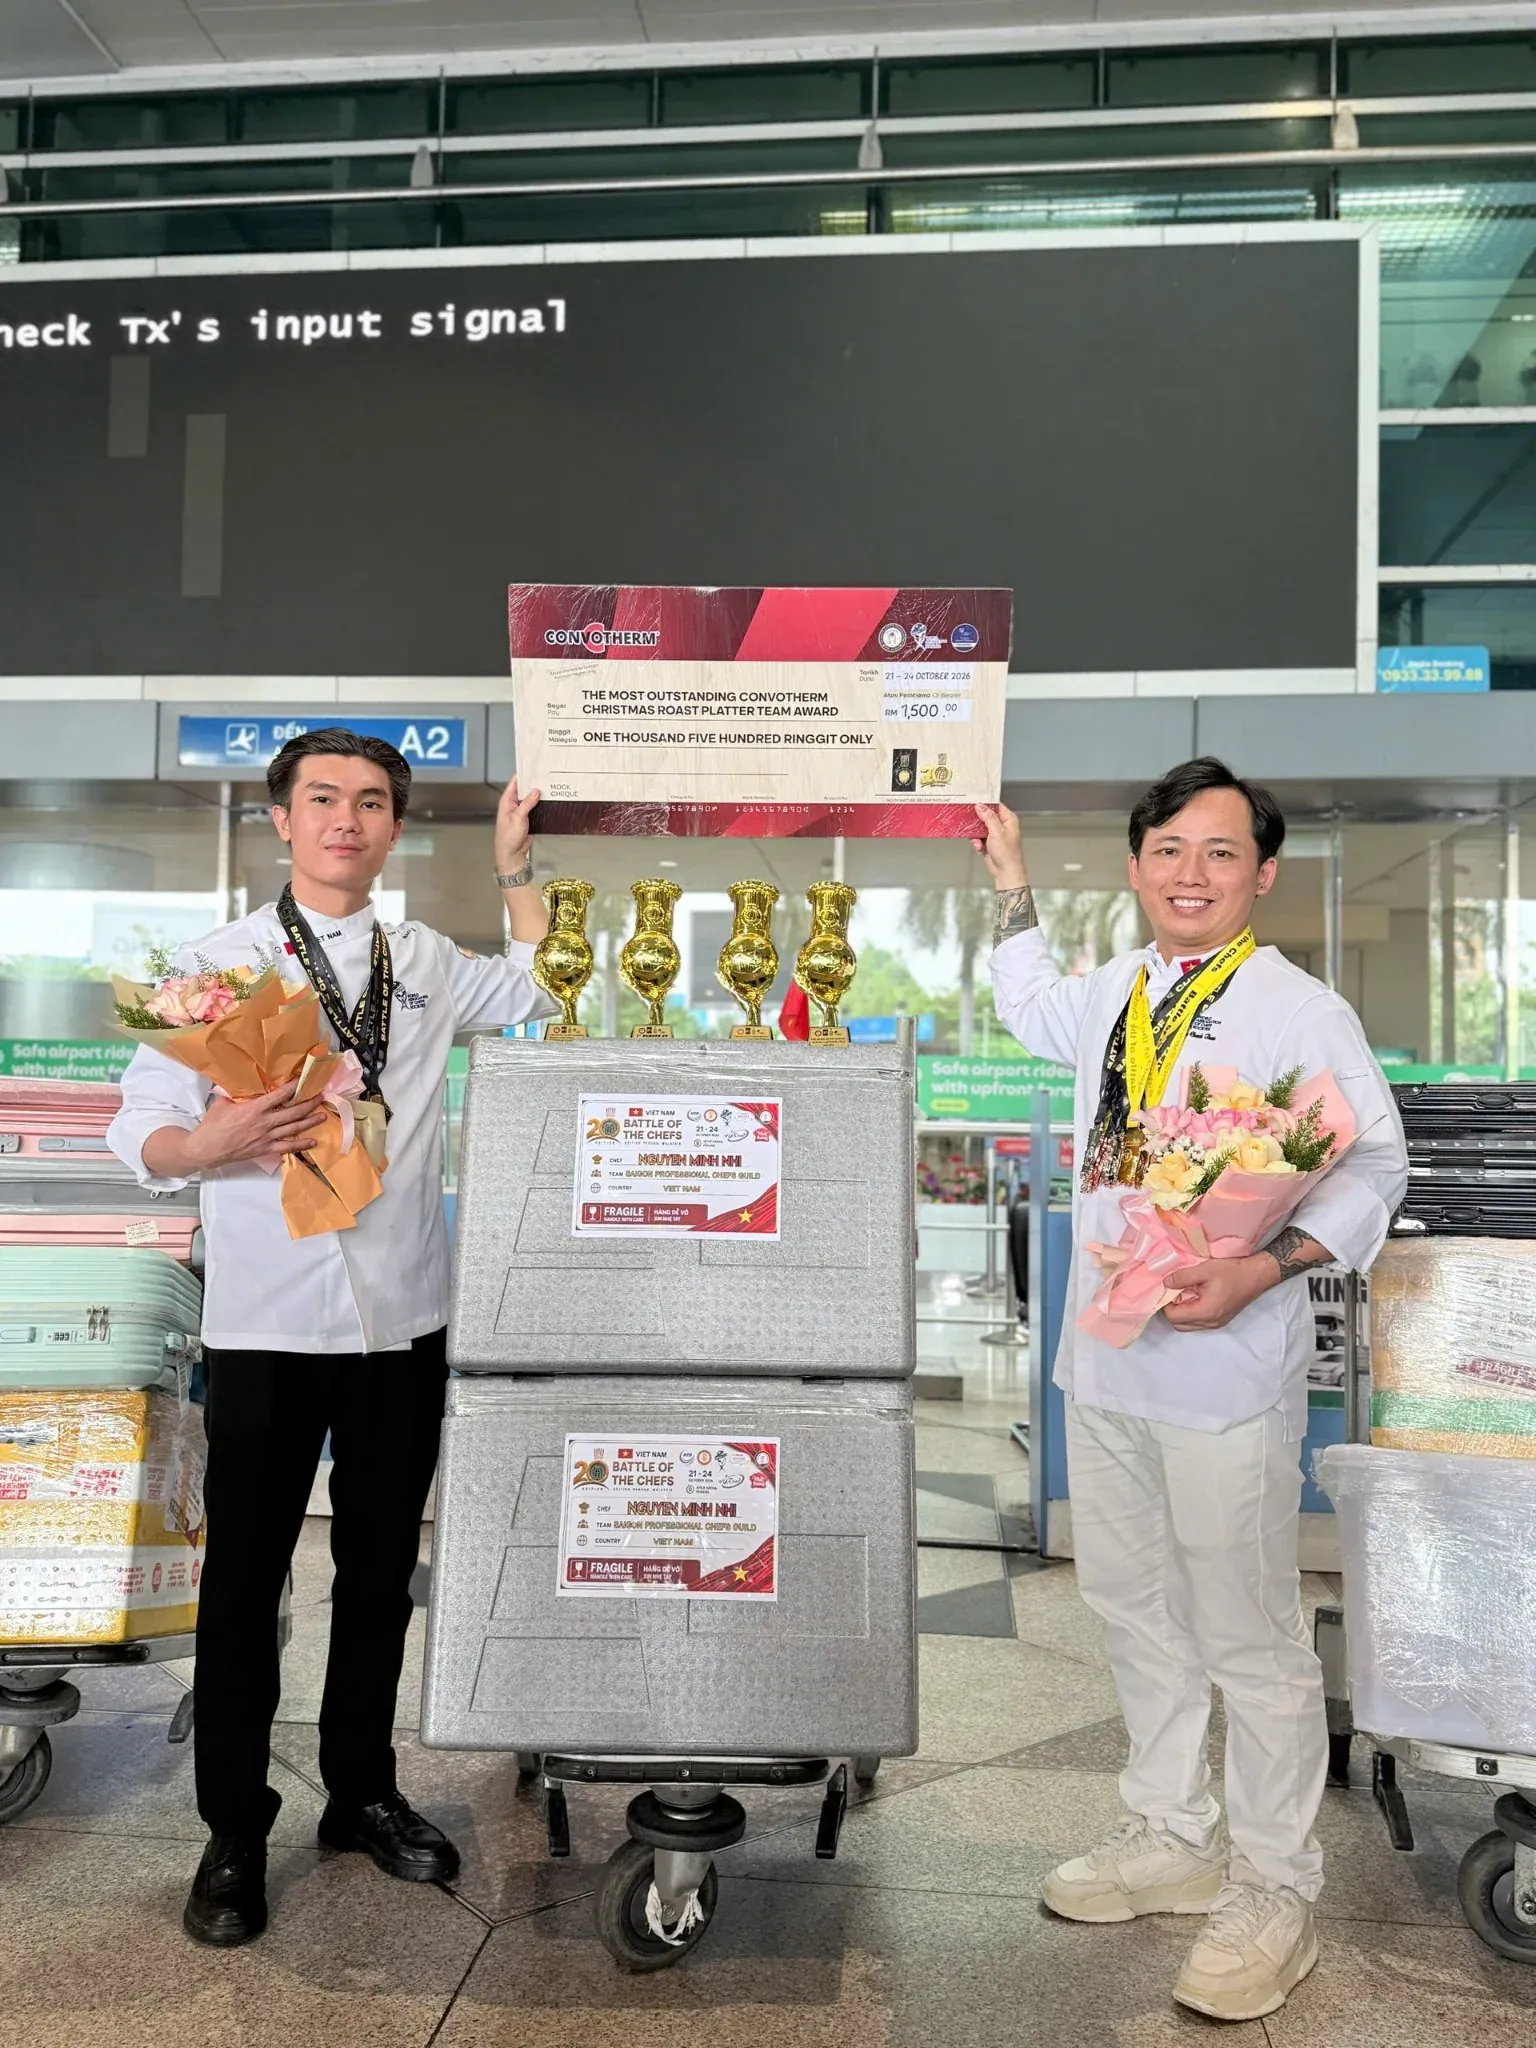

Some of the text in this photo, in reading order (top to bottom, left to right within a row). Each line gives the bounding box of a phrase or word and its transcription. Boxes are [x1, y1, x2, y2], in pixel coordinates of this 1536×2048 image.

[119, 310, 220, 345] Tx's
[250, 309, 382, 346] input
[410, 299, 566, 341] signal
[545, 629, 658, 646] CONVOTHERM
[885, 672, 894, 680] 21
[904, 672, 914, 680] 24
[915, 672, 949, 680] OCTOBER
[951, 672, 971, 680] 2026
[582, 690, 828, 702] THE MOST OUTSTANDING CONVOTHERM
[547, 702, 567, 710] Bayar
[582, 704, 839, 717] CHRISTMAS ROAST PLATTER TEAM AWARD
[901, 704, 939, 719] 1,500
[548, 728, 571, 736] Ringgit
[583, 732, 873, 744] ONE THOUSAND FIVE HUNDRED RINGGIT ONLY
[399, 725, 449, 760] A2
[548, 736, 577, 744] Malaysia
[327, 930, 342, 939] NAM
[290, 925, 310, 966] BATTLE
[1211, 947, 1237, 973] Chefs
[382, 983, 389, 997] OF
[1172, 989, 1198, 1023] Battle
[380, 1000, 388, 1041] BATTLE
[1153, 1019, 1165, 1034] OF
[12, 1043, 135, 1061] Safe airport ride
[1107, 1026, 1121, 1069] BATTLE
[12, 1061, 45, 1076] with
[47, 1062, 105, 1078] upfront
[931, 1061, 1075, 1080] Safe airport rides
[931, 1080, 968, 1095] with
[971, 1081, 1033, 1098] upfront
[623, 1119, 682, 1128] BATTLE OF
[623, 1130, 683, 1140] THE CHEFS
[638, 1153, 687, 1166] NGUYEN
[689, 1154, 719, 1167] MINH
[721, 1154, 742, 1167] NHI
[655, 1170, 710, 1179] PROFESSIONAL
[663, 1184, 680, 1192] VIET
[603, 1206, 645, 1217] FRAGILE
[612, 1461, 674, 1473] BATTLE OF
[612, 1475, 674, 1486] THE CHEFS
[627, 1500, 678, 1516] NGUYEN
[681, 1502, 713, 1516] MINH
[716, 1503, 737, 1517] NHI
[613, 1521, 643, 1529] SAIGON
[644, 1521, 704, 1530] PROFESSIONAL
[653, 1537, 672, 1545] VIET
[590, 1562, 633, 1573] FRAGILE
